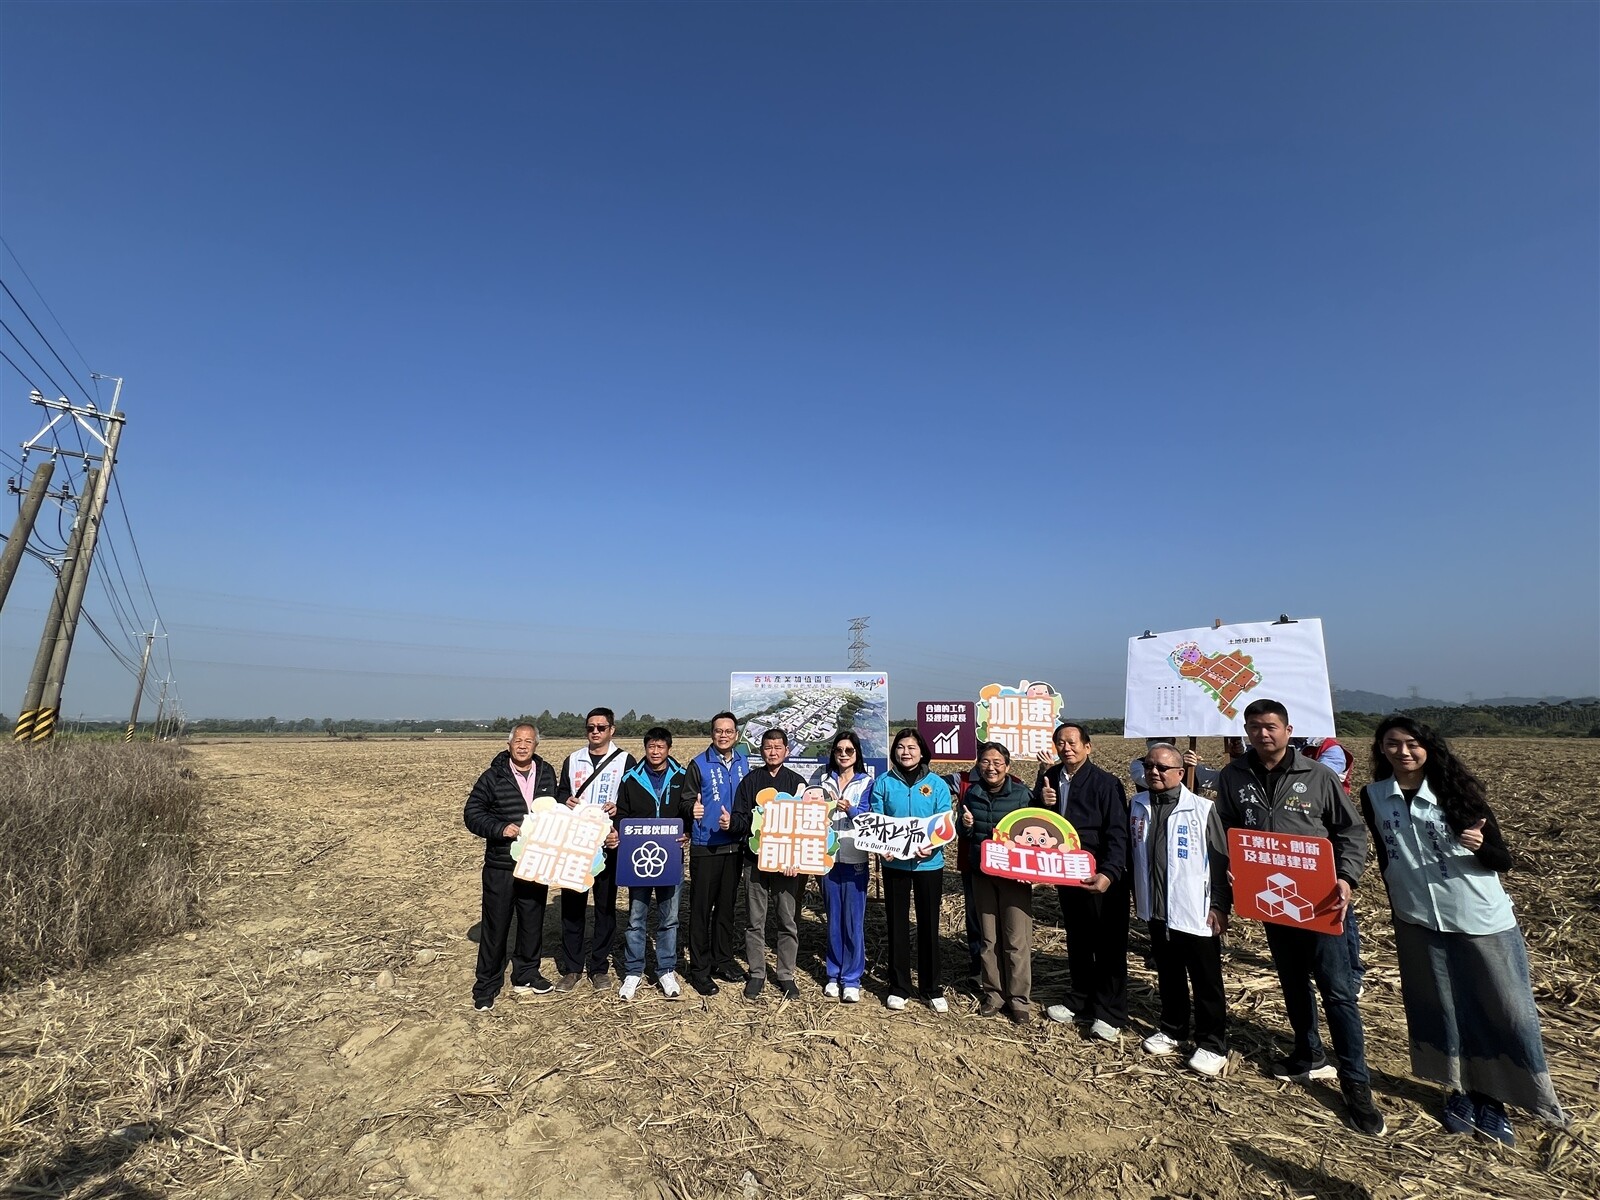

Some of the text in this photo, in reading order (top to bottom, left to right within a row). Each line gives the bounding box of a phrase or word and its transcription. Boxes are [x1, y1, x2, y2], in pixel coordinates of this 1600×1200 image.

[754, 675, 832, 683] 古坑產業加值園區
[926, 704, 966, 713] 合適的工作
[926, 714, 966, 722] 及經濟成長
[989, 697, 1053, 727] 加速
[529, 812, 603, 855] 加速
[763, 801, 827, 836] 加速
[854, 814, 926, 857] 雲林上場
[856, 840, 900, 853] It's Our Time
[1238, 834, 1320, 856] 工業化、創新
[517, 843, 590, 891] 前進
[761, 835, 825, 872] 前進
[985, 842, 1092, 880] 農工並重
[1243, 849, 1317, 871] 及基礎建設
